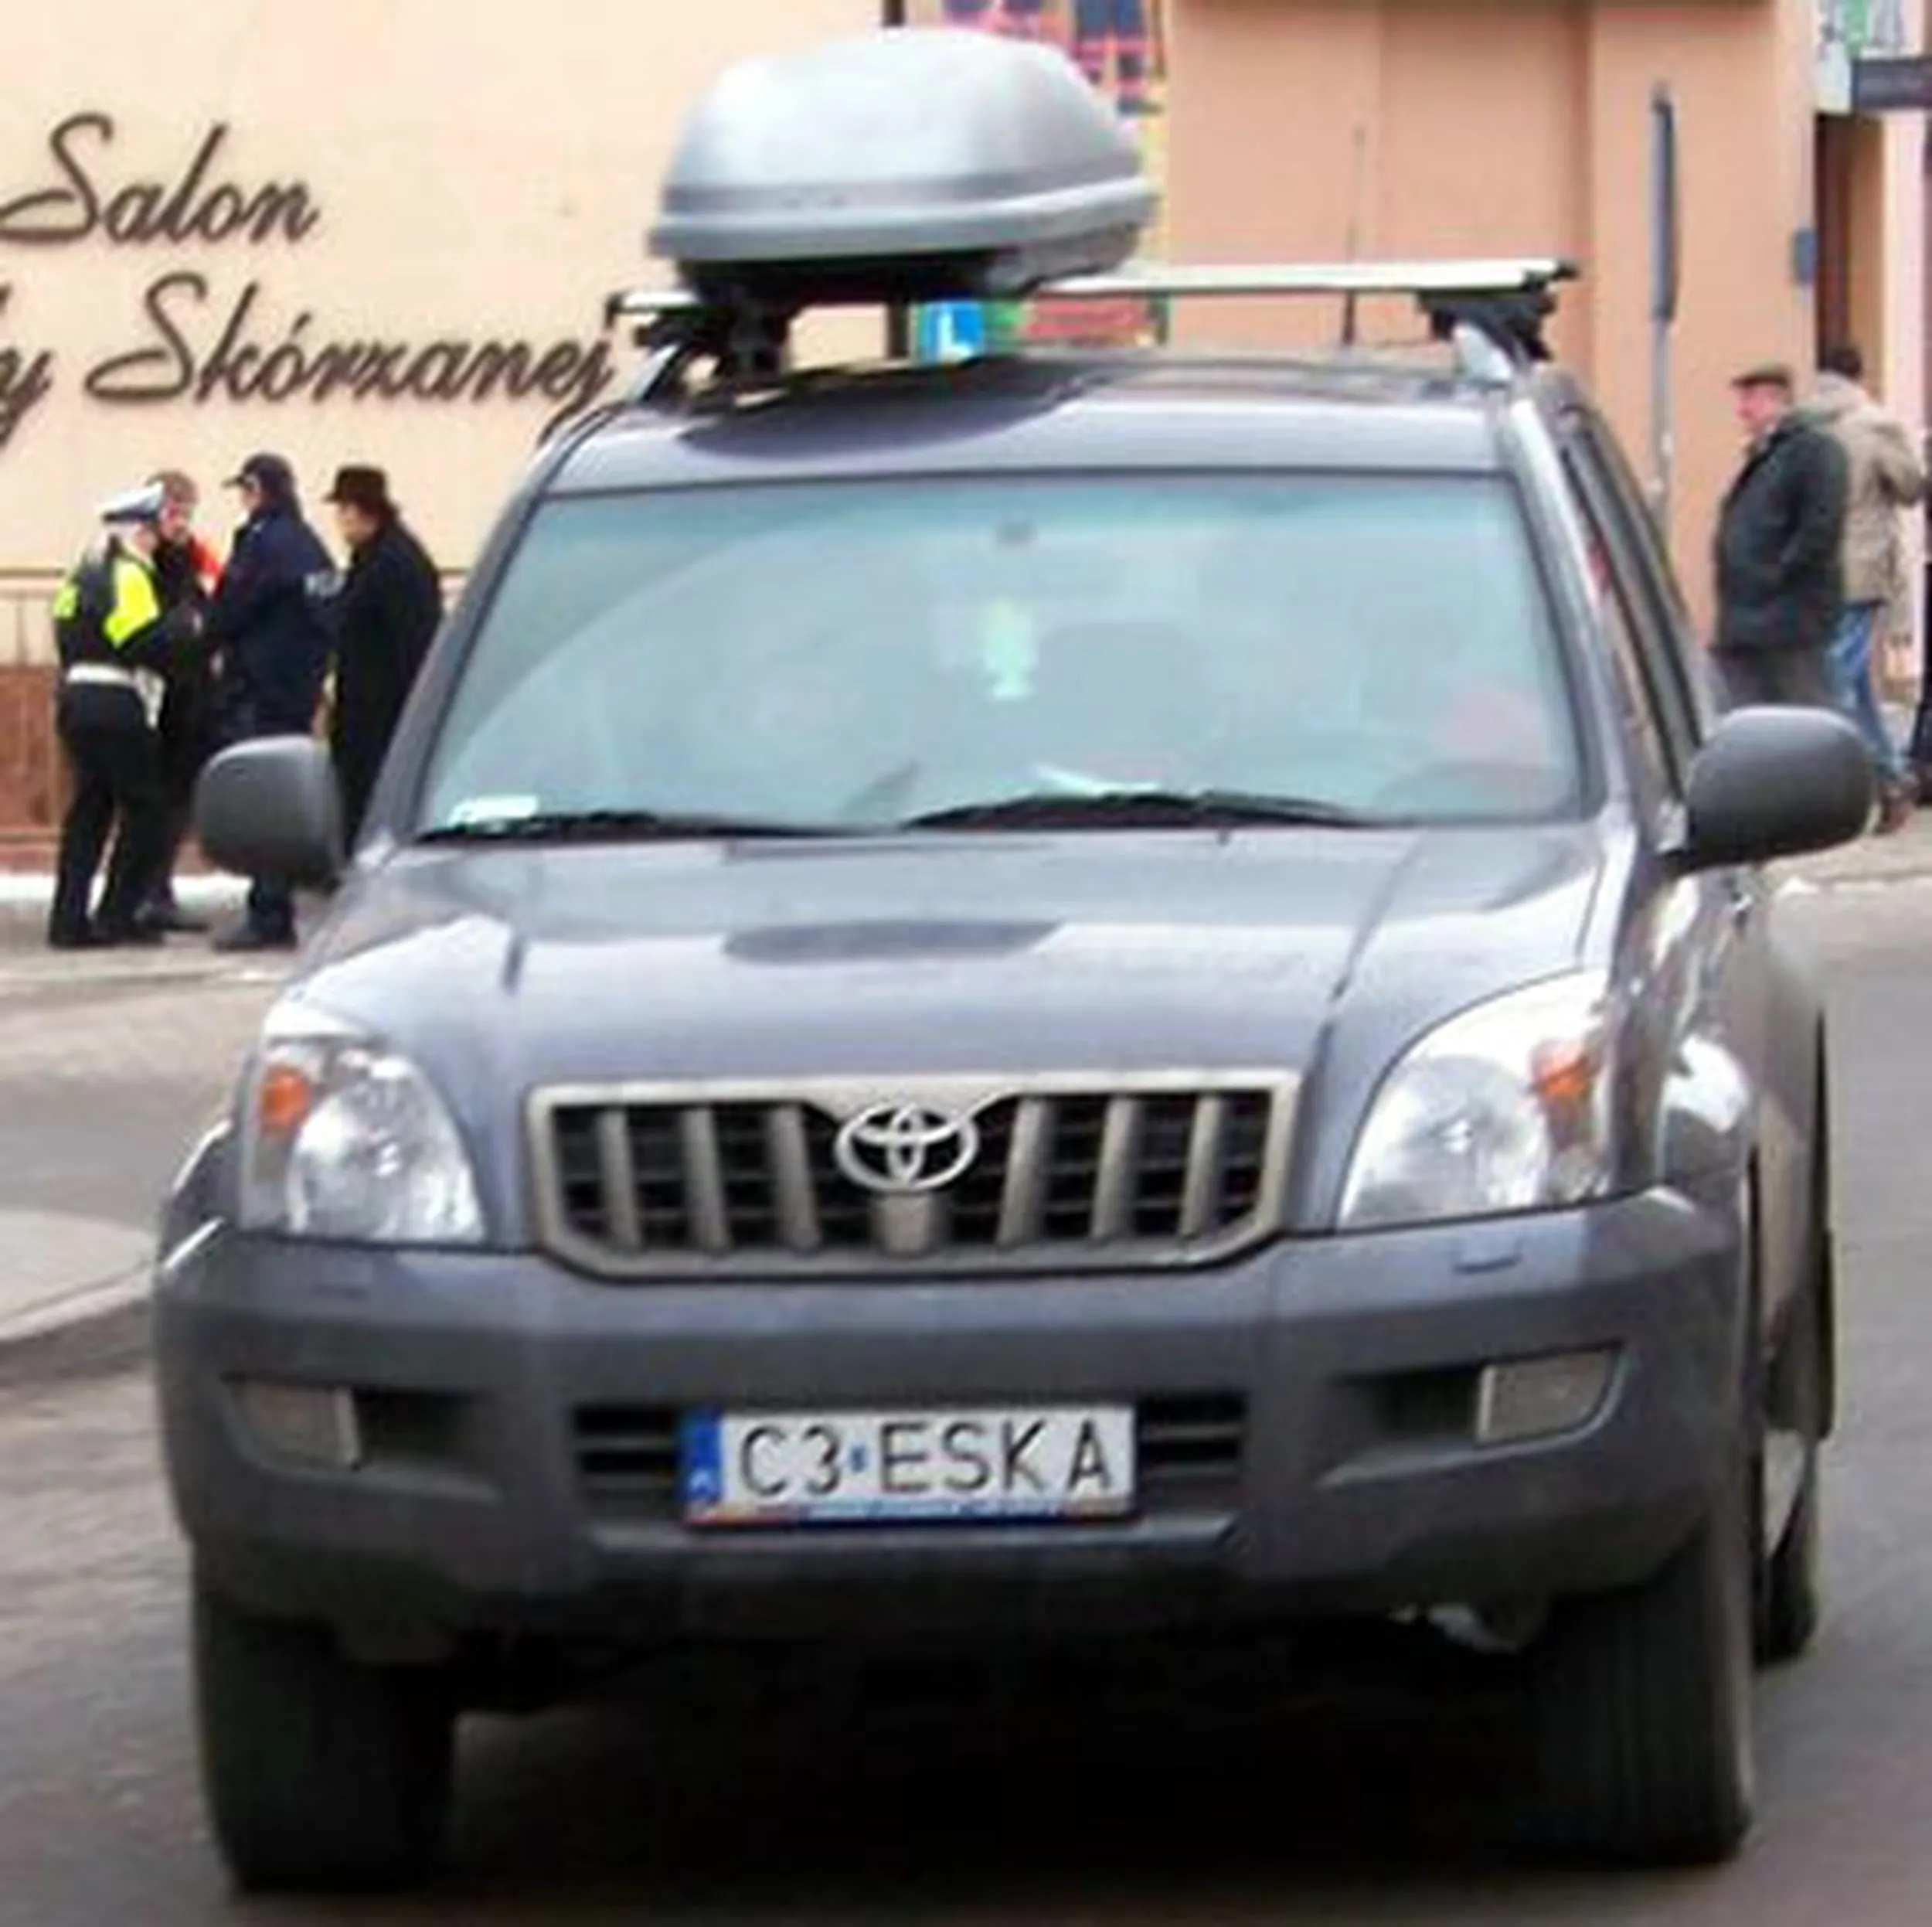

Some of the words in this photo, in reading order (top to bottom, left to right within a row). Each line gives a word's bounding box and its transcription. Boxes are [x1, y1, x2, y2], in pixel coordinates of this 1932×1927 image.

[0, 113, 320, 243] Salon
[83, 271, 615, 446] Skórzanej
[740, 1423, 842, 1496] C3
[878, 1418, 1114, 1494] ESKA
